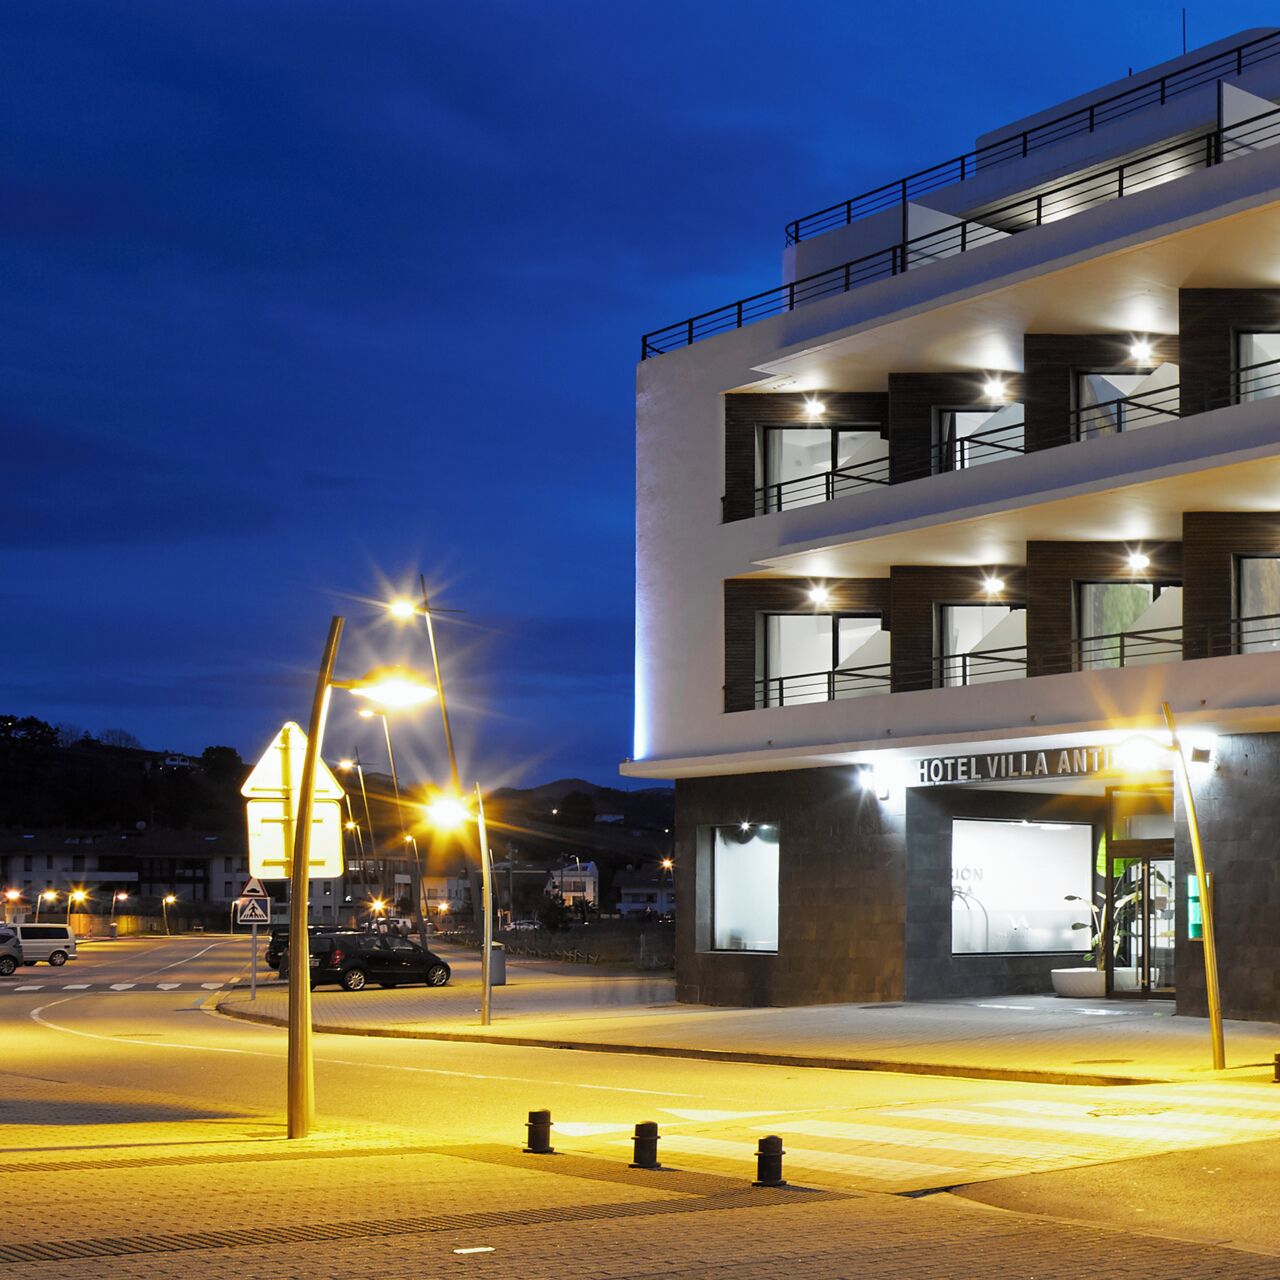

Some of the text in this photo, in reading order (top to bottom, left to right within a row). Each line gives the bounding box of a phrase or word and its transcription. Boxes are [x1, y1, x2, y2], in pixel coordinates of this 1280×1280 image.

[919, 747, 1113, 783] HOTEL VILLA ANTI
